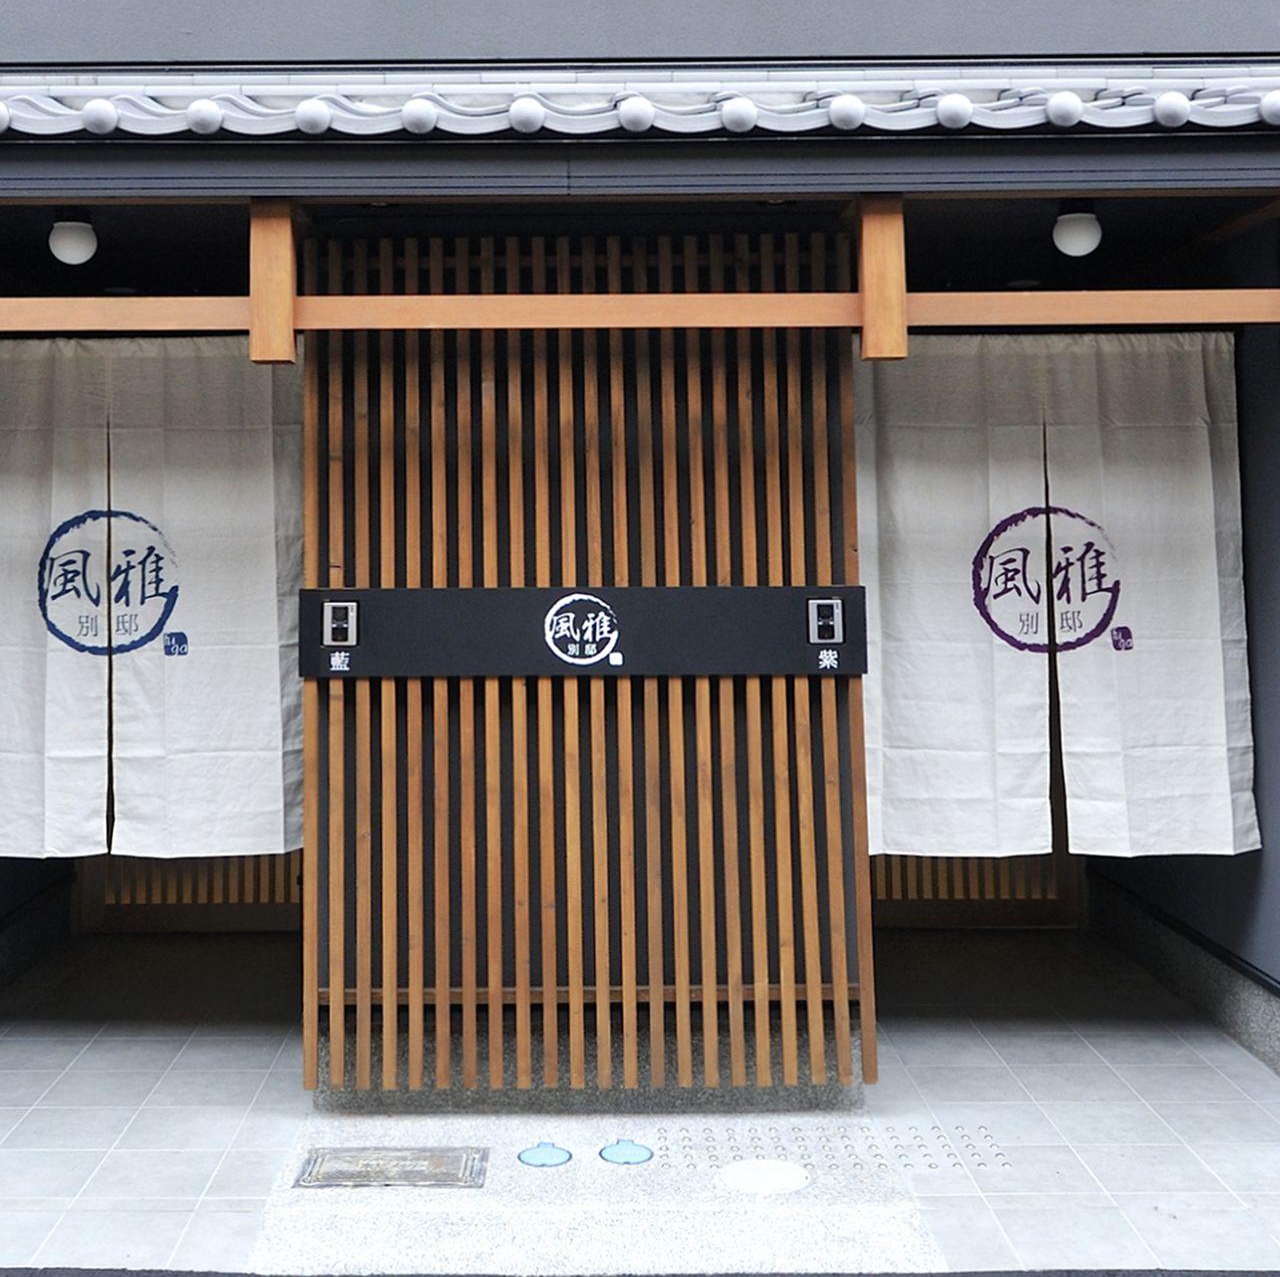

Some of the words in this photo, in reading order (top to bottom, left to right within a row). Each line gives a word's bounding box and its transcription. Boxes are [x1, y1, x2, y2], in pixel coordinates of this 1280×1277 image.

[47, 545, 170, 608] 風雅
[985, 541, 1114, 605] 風雅
[77, 613, 139, 637] 別邸
[552, 611, 612, 642] 風雅
[1019, 610, 1083, 635] 別邸
[818, 649, 838, 669] 紫
